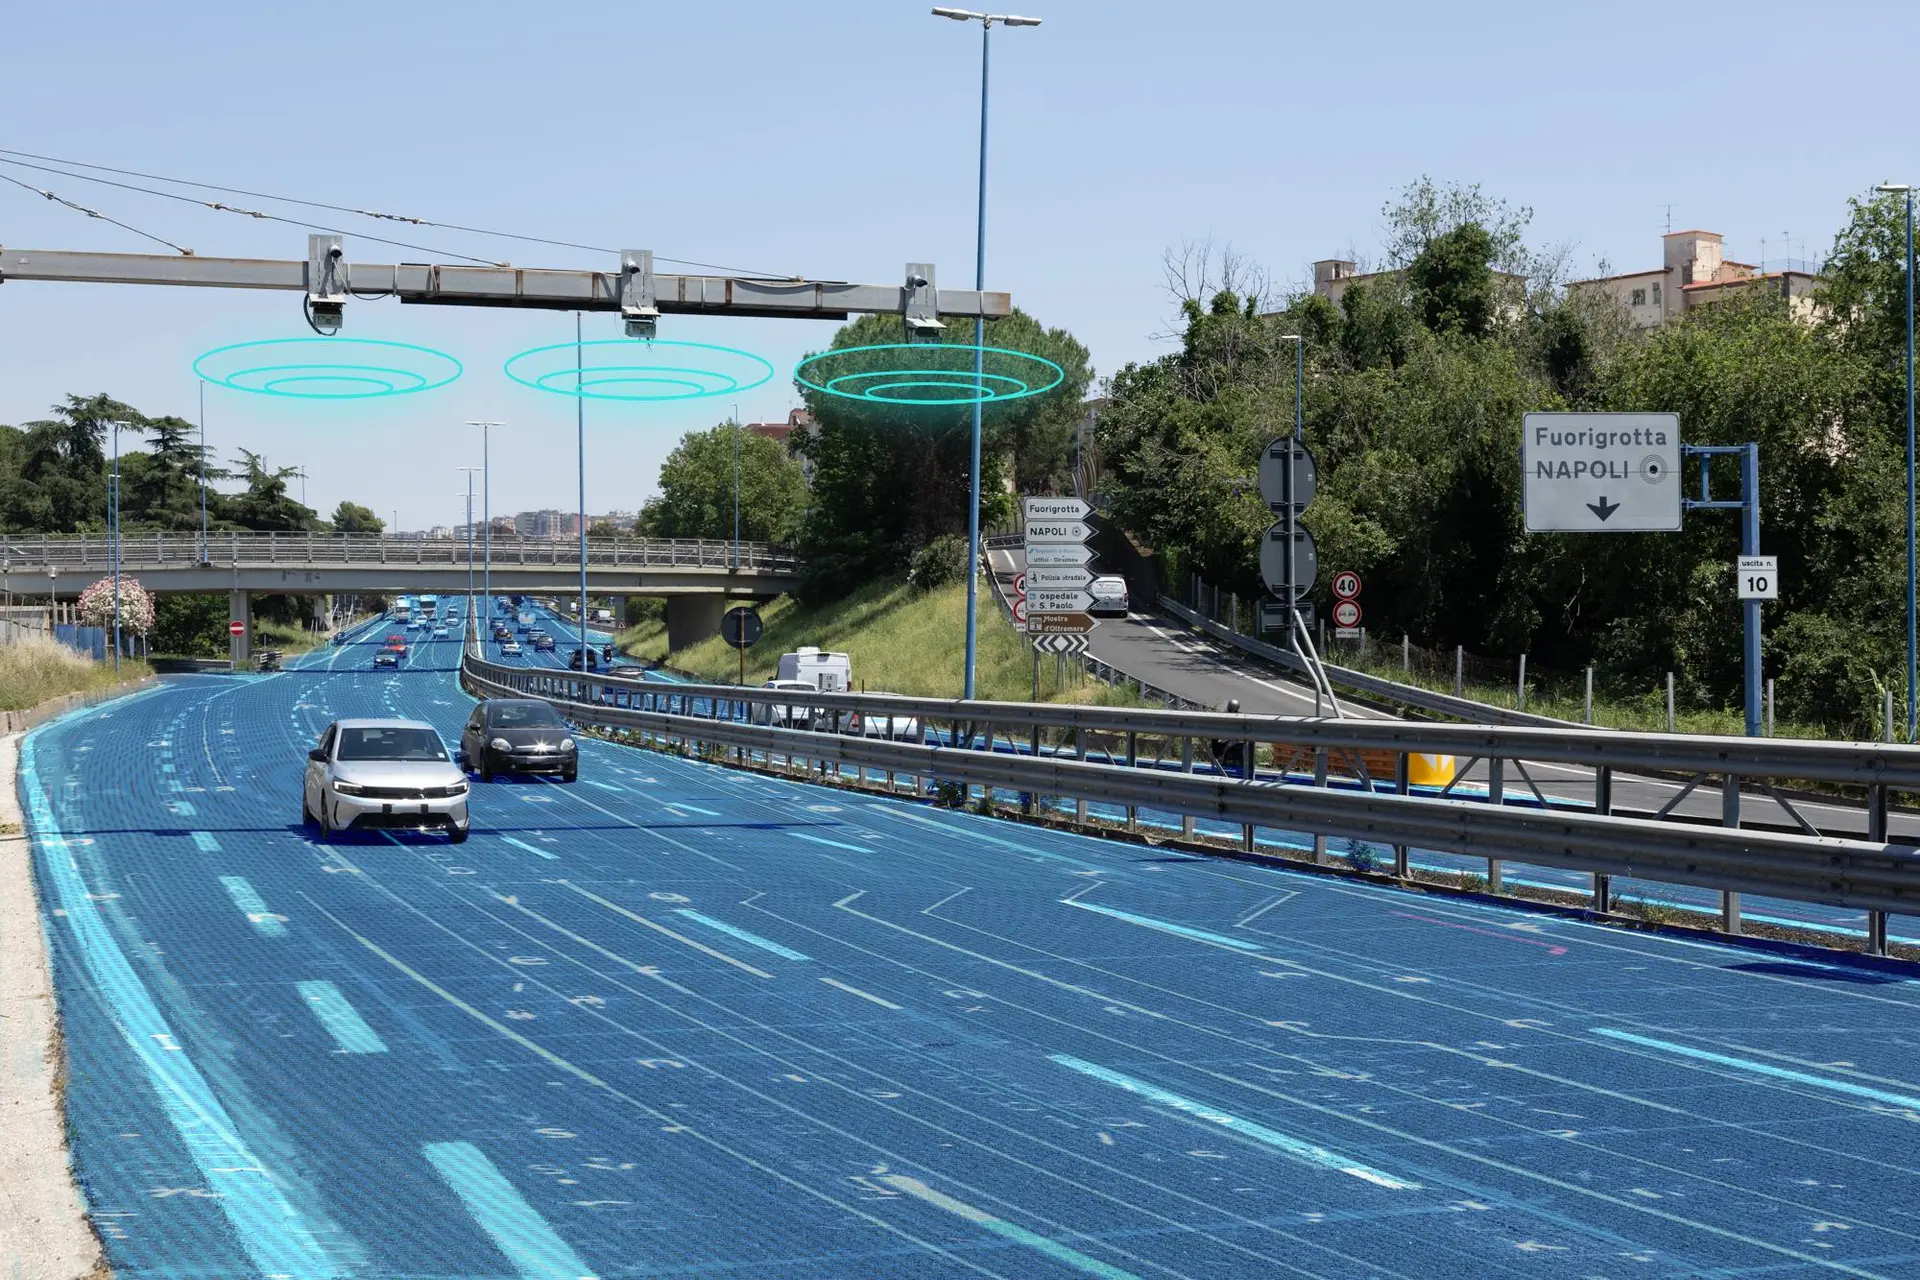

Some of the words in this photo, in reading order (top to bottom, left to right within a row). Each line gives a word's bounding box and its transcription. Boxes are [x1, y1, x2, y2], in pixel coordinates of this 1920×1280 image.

[1535, 427, 1667, 449] Fuorigrotta
[1536, 460, 1629, 479] NAPOLI
[1029, 505, 1080, 514] Fuorigrotta
[1030, 527, 1067, 536] NAPOLI
[1339, 580, 1355, 592] 40
[1747, 576, 1768, 592] 10
